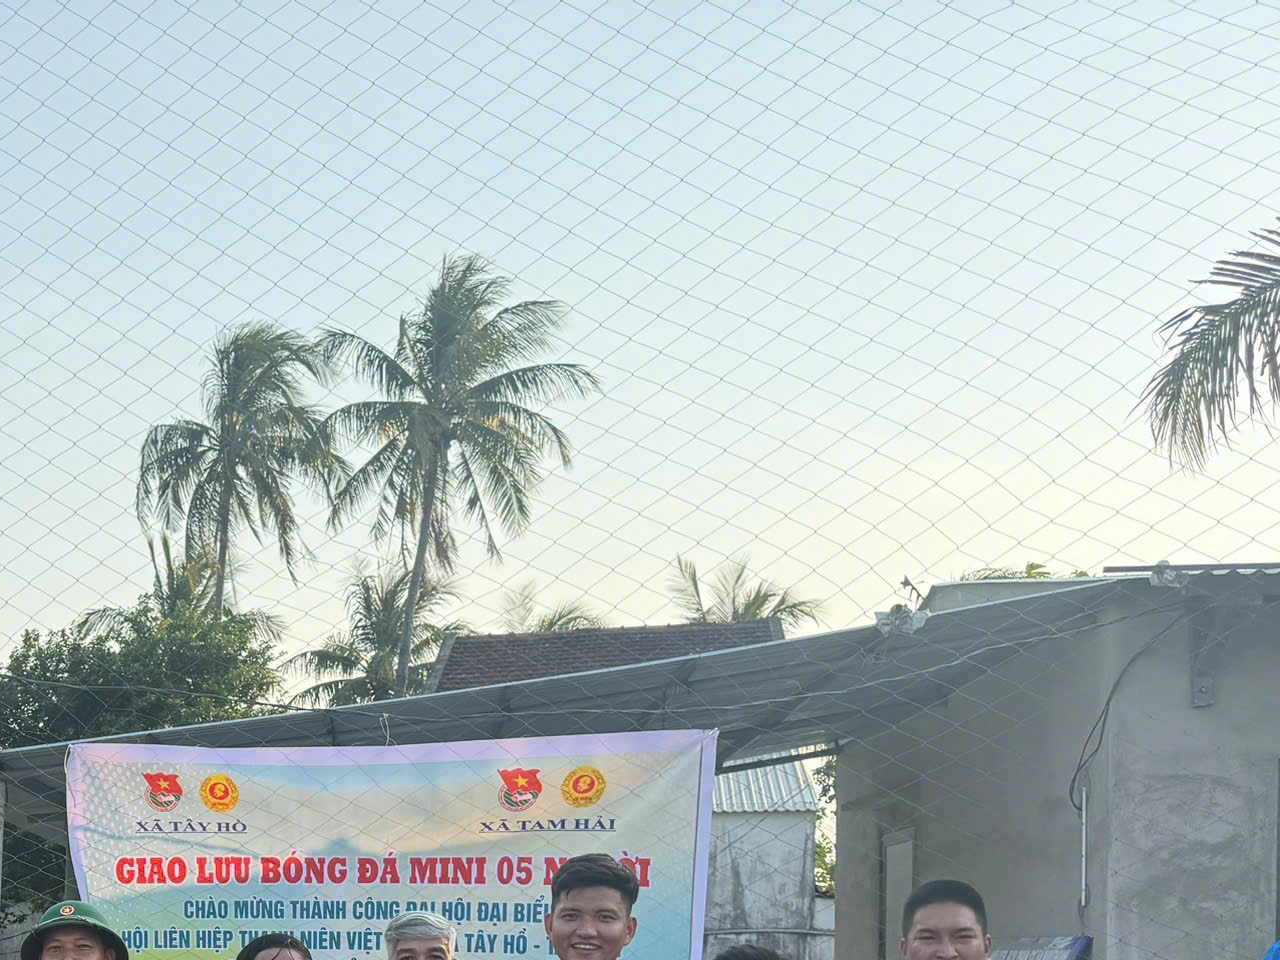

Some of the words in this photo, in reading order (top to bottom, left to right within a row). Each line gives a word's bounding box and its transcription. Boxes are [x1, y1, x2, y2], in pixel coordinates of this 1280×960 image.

[135, 819, 164, 832] XÃ
[169, 818, 212, 832] TÂY
[480, 818, 510, 832] XÃ
[517, 818, 568, 831] TAM
[573, 815, 616, 831] HẢI
[116, 856, 187, 884] GIAO
[196, 856, 251, 884] LƯU
[261, 850, 348, 884] BÓNG
[357, 851, 401, 885] ĐÁ
[409, 856, 487, 885] MINI
[497, 856, 533, 886] 05
[184, 896, 229, 919] CHÀO
[234, 896, 285, 920] MỪNG
[289, 896, 347, 920] THÀNH
[352, 896, 401, 920] CÔNG
[442, 897, 471, 926] HỘI
[477, 901, 508, 926] ĐẠI
[121, 926, 149, 953] HỘI
[154, 926, 191, 949] LIÊN
[196, 926, 234, 953] HIỆP
[299, 926, 341, 950] NIÊN
[347, 927, 384, 955] VIỆT
[464, 929, 498, 953] TÂY
[503, 927, 528, 955] HỒ
